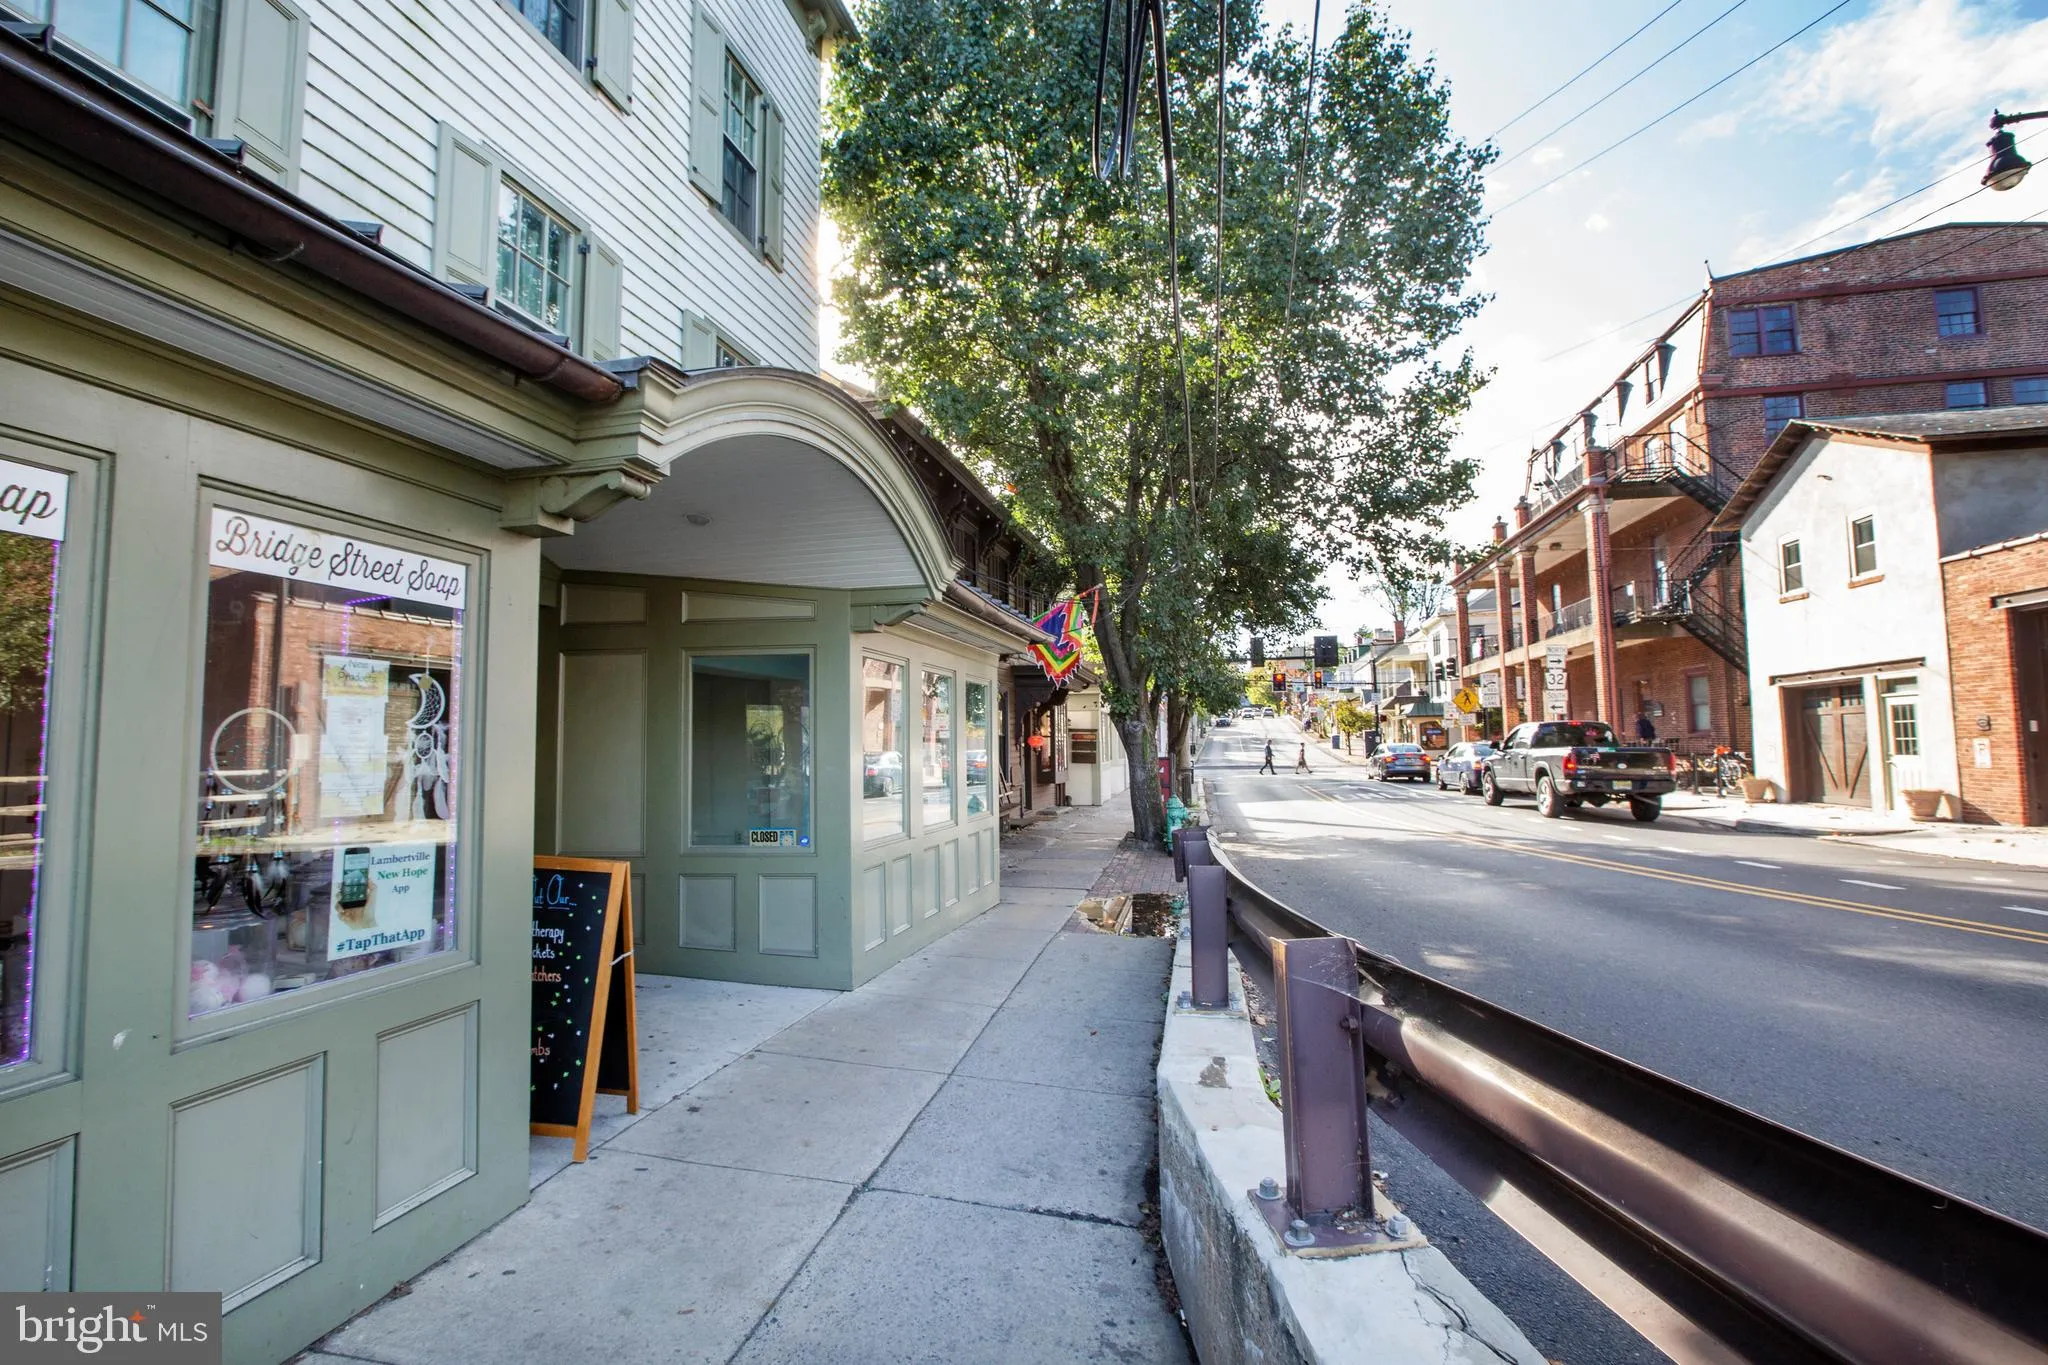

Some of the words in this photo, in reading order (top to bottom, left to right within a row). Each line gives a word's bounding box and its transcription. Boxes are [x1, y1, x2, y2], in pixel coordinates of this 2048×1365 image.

[215, 516, 325, 575] Bridge
[327, 541, 405, 585] Street
[407, 559, 462, 601] Soap
[1548, 673, 1564, 685] 32
[751, 830, 778, 843] CLOSED
[371, 851, 431, 866] Lambertville
[377, 870, 399, 881] New
[402, 867, 429, 878] Hope
[391, 883, 410, 894] App
[336, 927, 426, 953] #TapThatApp
